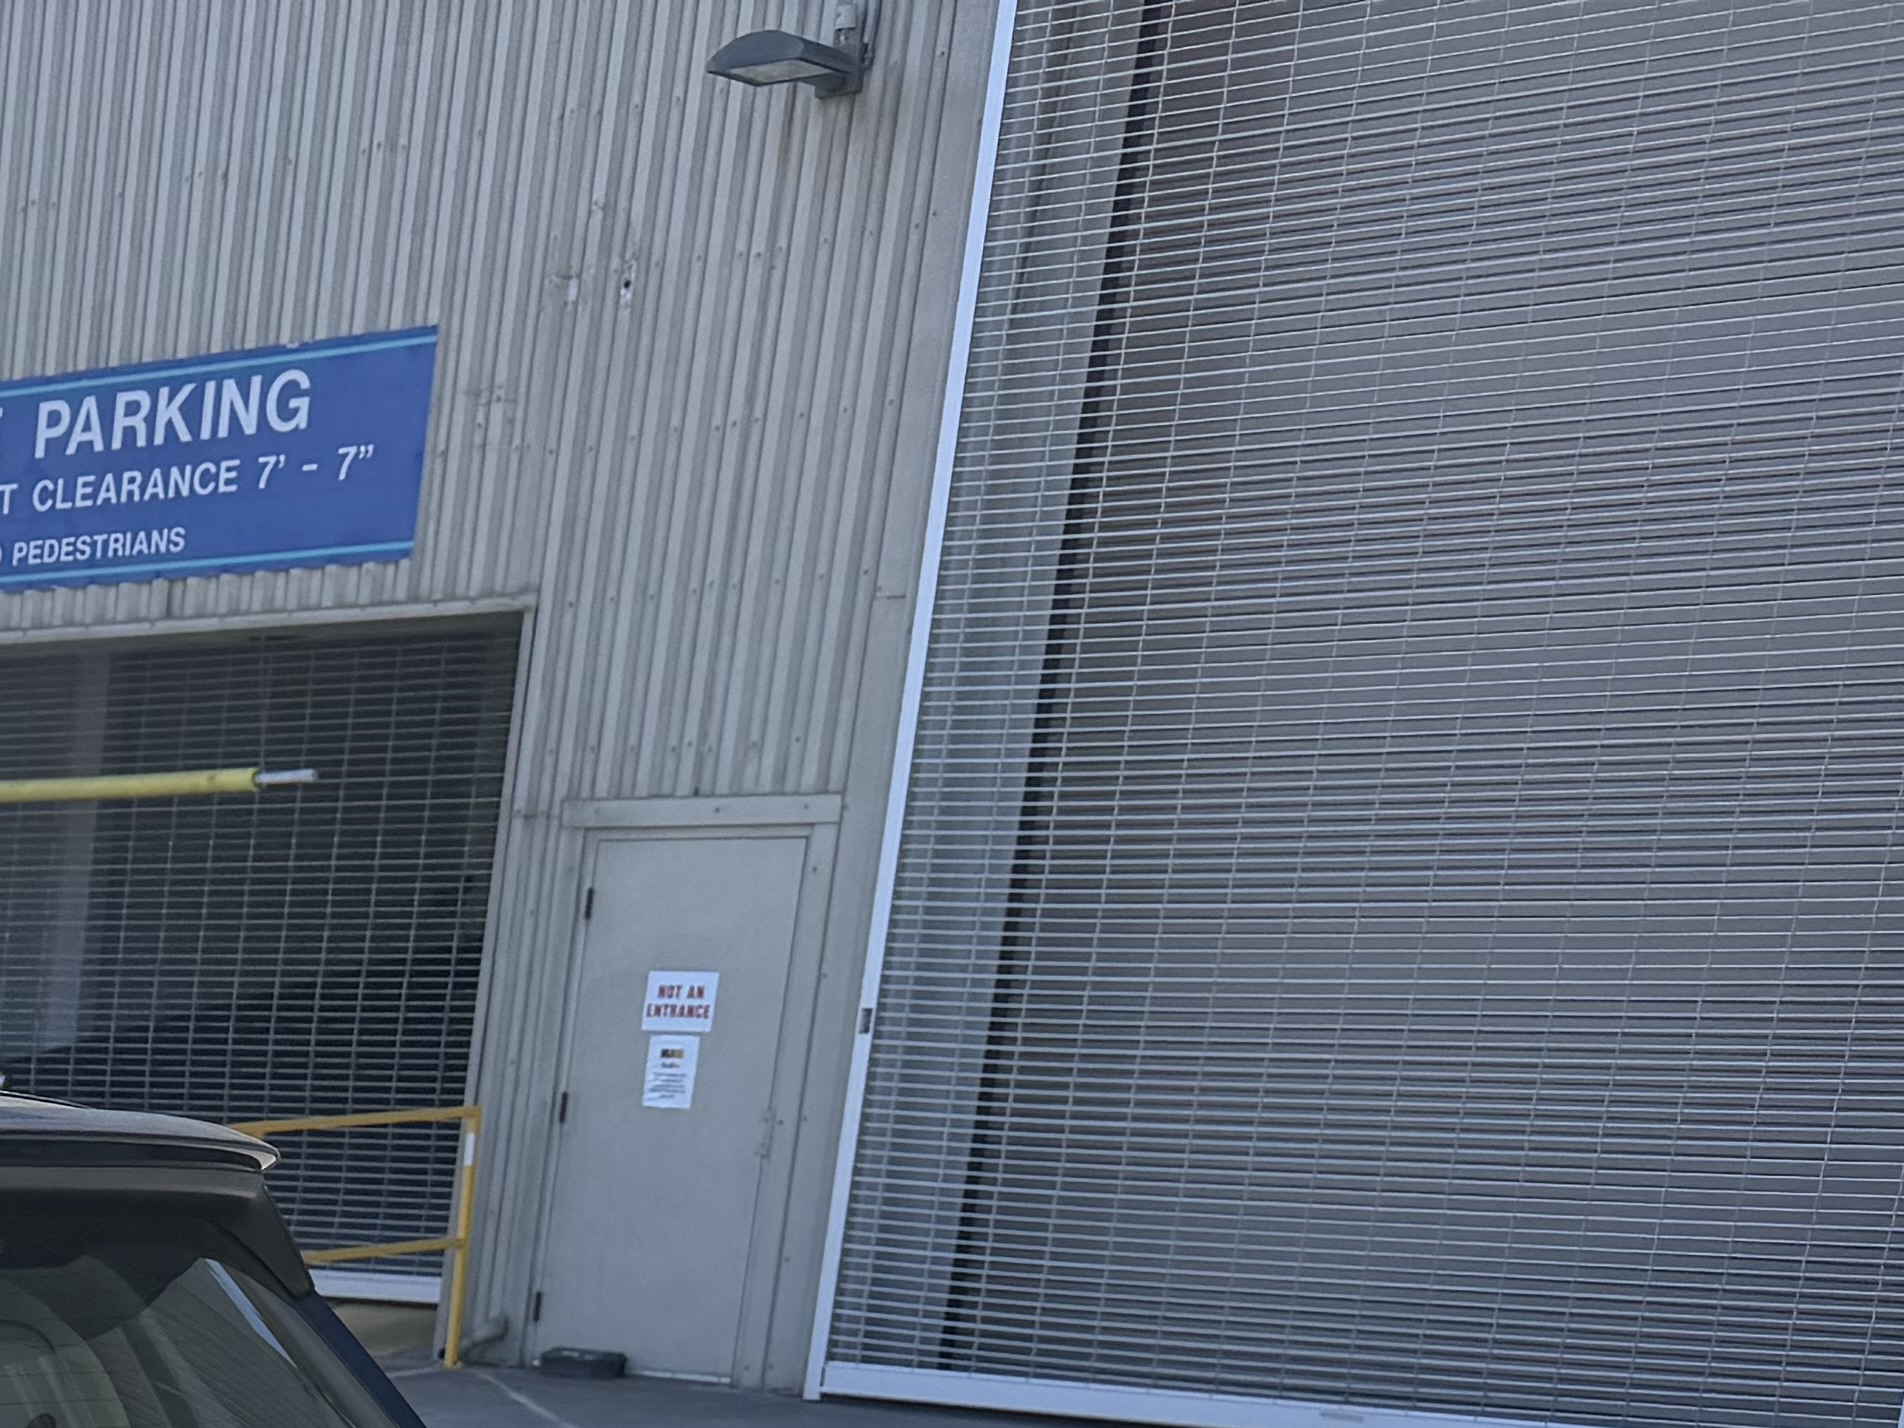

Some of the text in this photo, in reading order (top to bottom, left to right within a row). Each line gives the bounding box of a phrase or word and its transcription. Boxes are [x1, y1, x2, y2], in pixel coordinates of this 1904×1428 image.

[34, 370, 311, 460] PARKING
[33, 460, 239, 512] CLEARANCE
[12, 528, 186, 565] PEDESTRIANS
[657, 984, 706, 999] NOT AN
[646, 1003, 711, 1020] ENTRANCE
